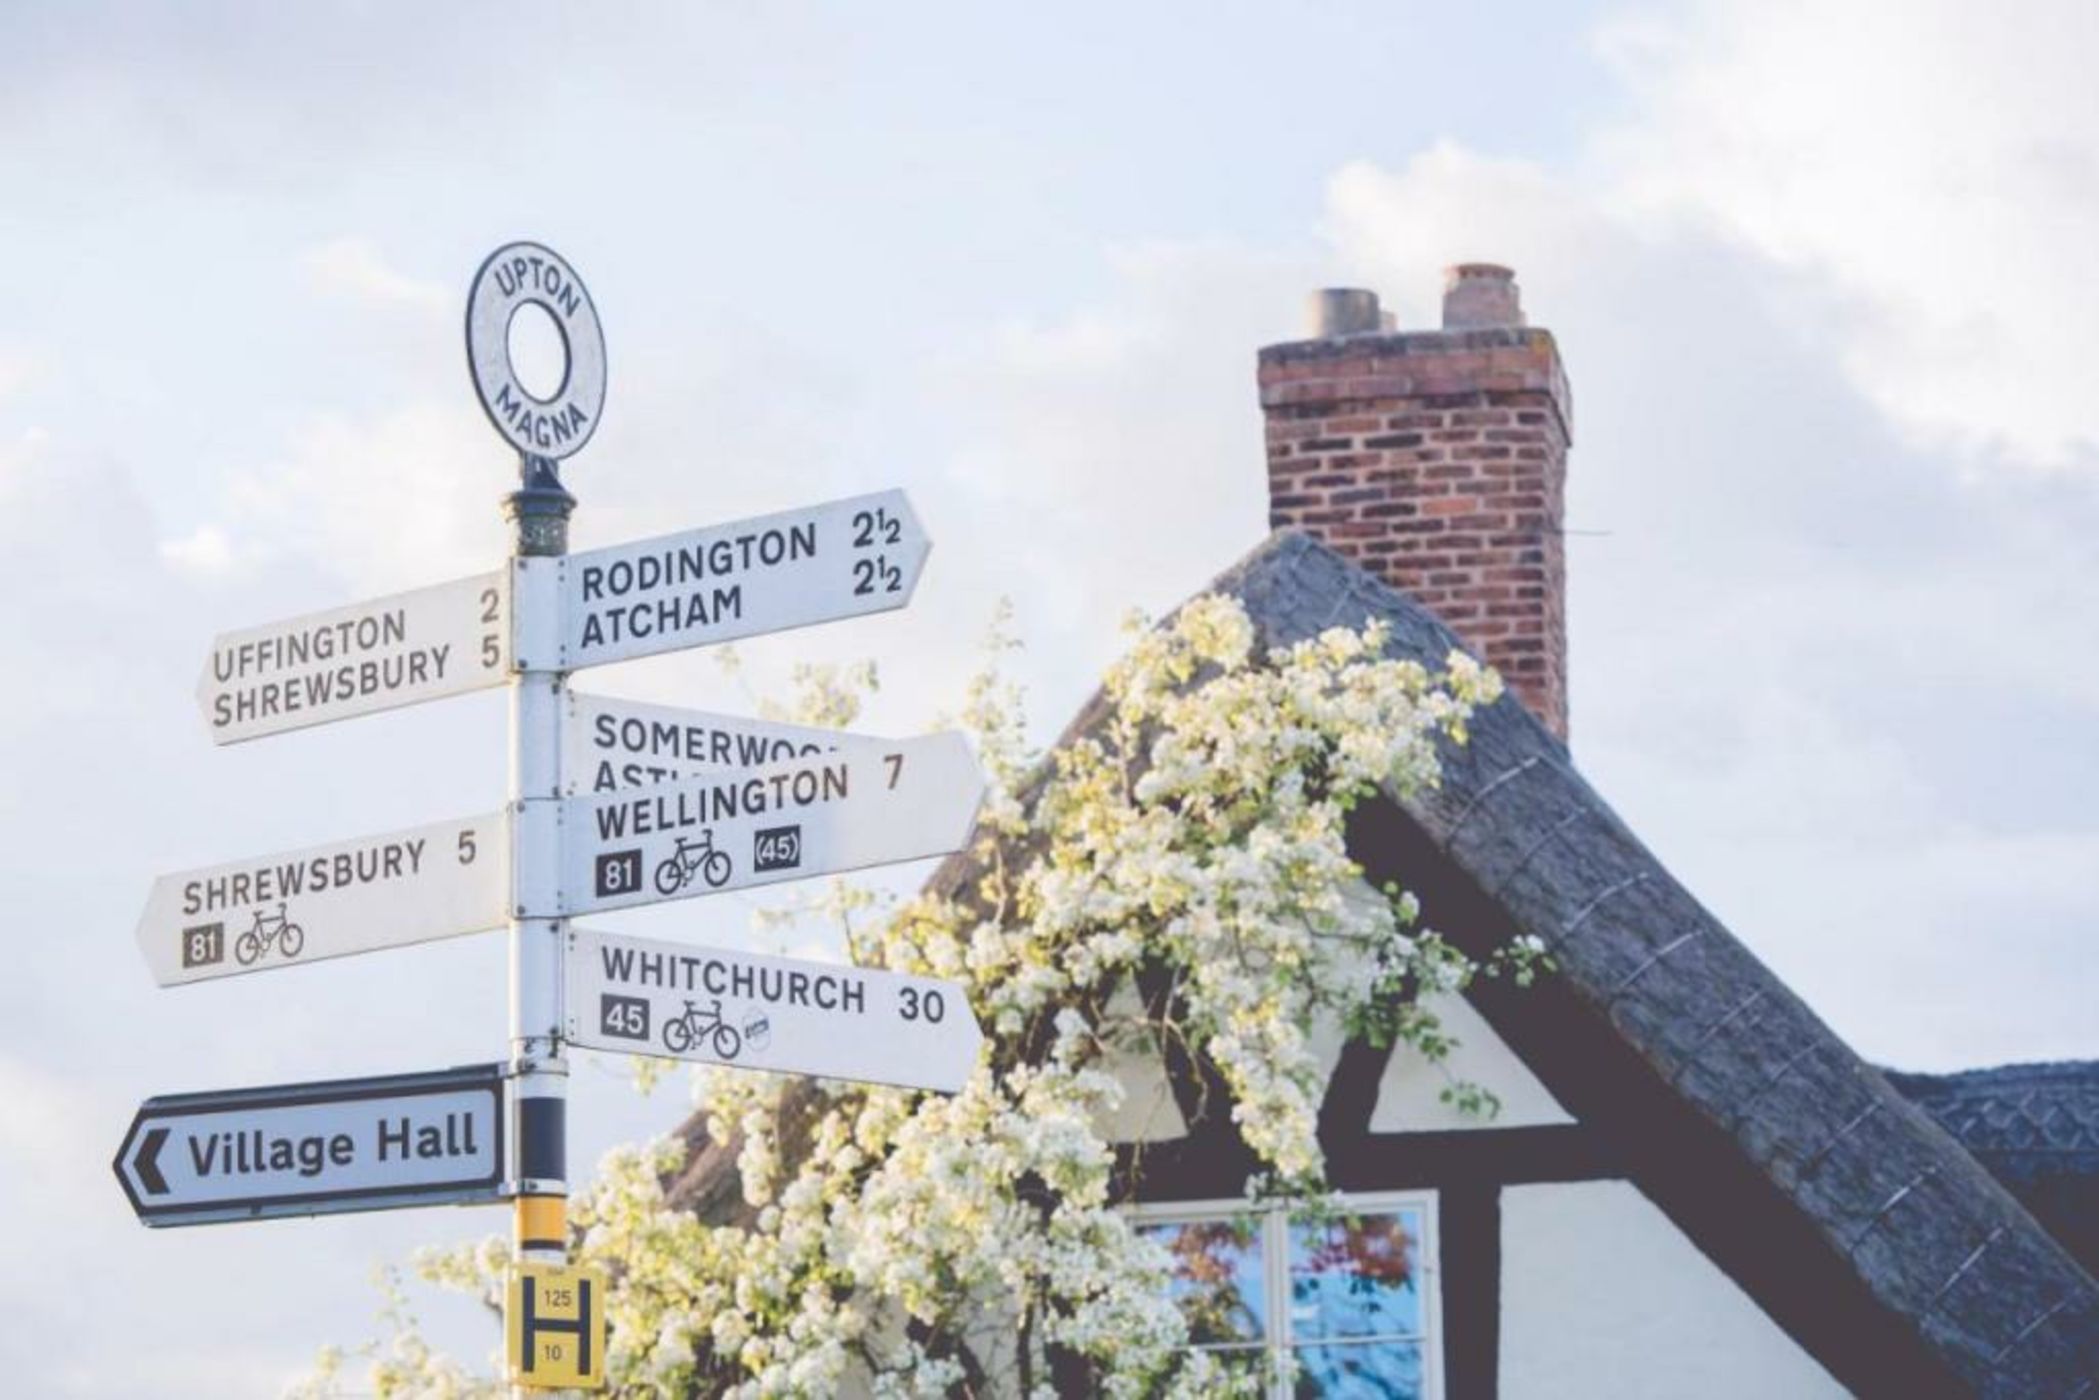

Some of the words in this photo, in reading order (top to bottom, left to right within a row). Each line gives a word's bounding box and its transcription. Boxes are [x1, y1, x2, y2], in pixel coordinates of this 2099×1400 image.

[494, 256, 581, 319] UPTON
[496, 383, 588, 449] MAGNA
[582, 522, 817, 602] RODINGTON
[213, 608, 406, 683] UFFINGTON
[480, 588, 500, 624] 2
[581, 585, 742, 649] ATCHAM
[213, 643, 451, 728] SHREWSBURY
[481, 634, 500, 669] 5
[594, 713, 838, 768] SOMERWO
[596, 763, 849, 842] WELLINGTON
[883, 753, 904, 791] 7
[182, 838, 427, 916] SHREWSBURY
[457, 829, 477, 866] 5
[604, 859, 635, 891] 81
[754, 830, 800, 864] (45)
[189, 932, 219, 962] 81
[600, 945, 865, 1014] WHITCHURCH
[898, 986, 945, 1024] 30
[605, 1001, 644, 1036] 45
[188, 1130, 355, 1178] Village
[377, 1111, 478, 1163] Hall
[522, 1276, 591, 1376] H
[544, 1288, 572, 1308] 125
[544, 1344, 563, 1361] 10
